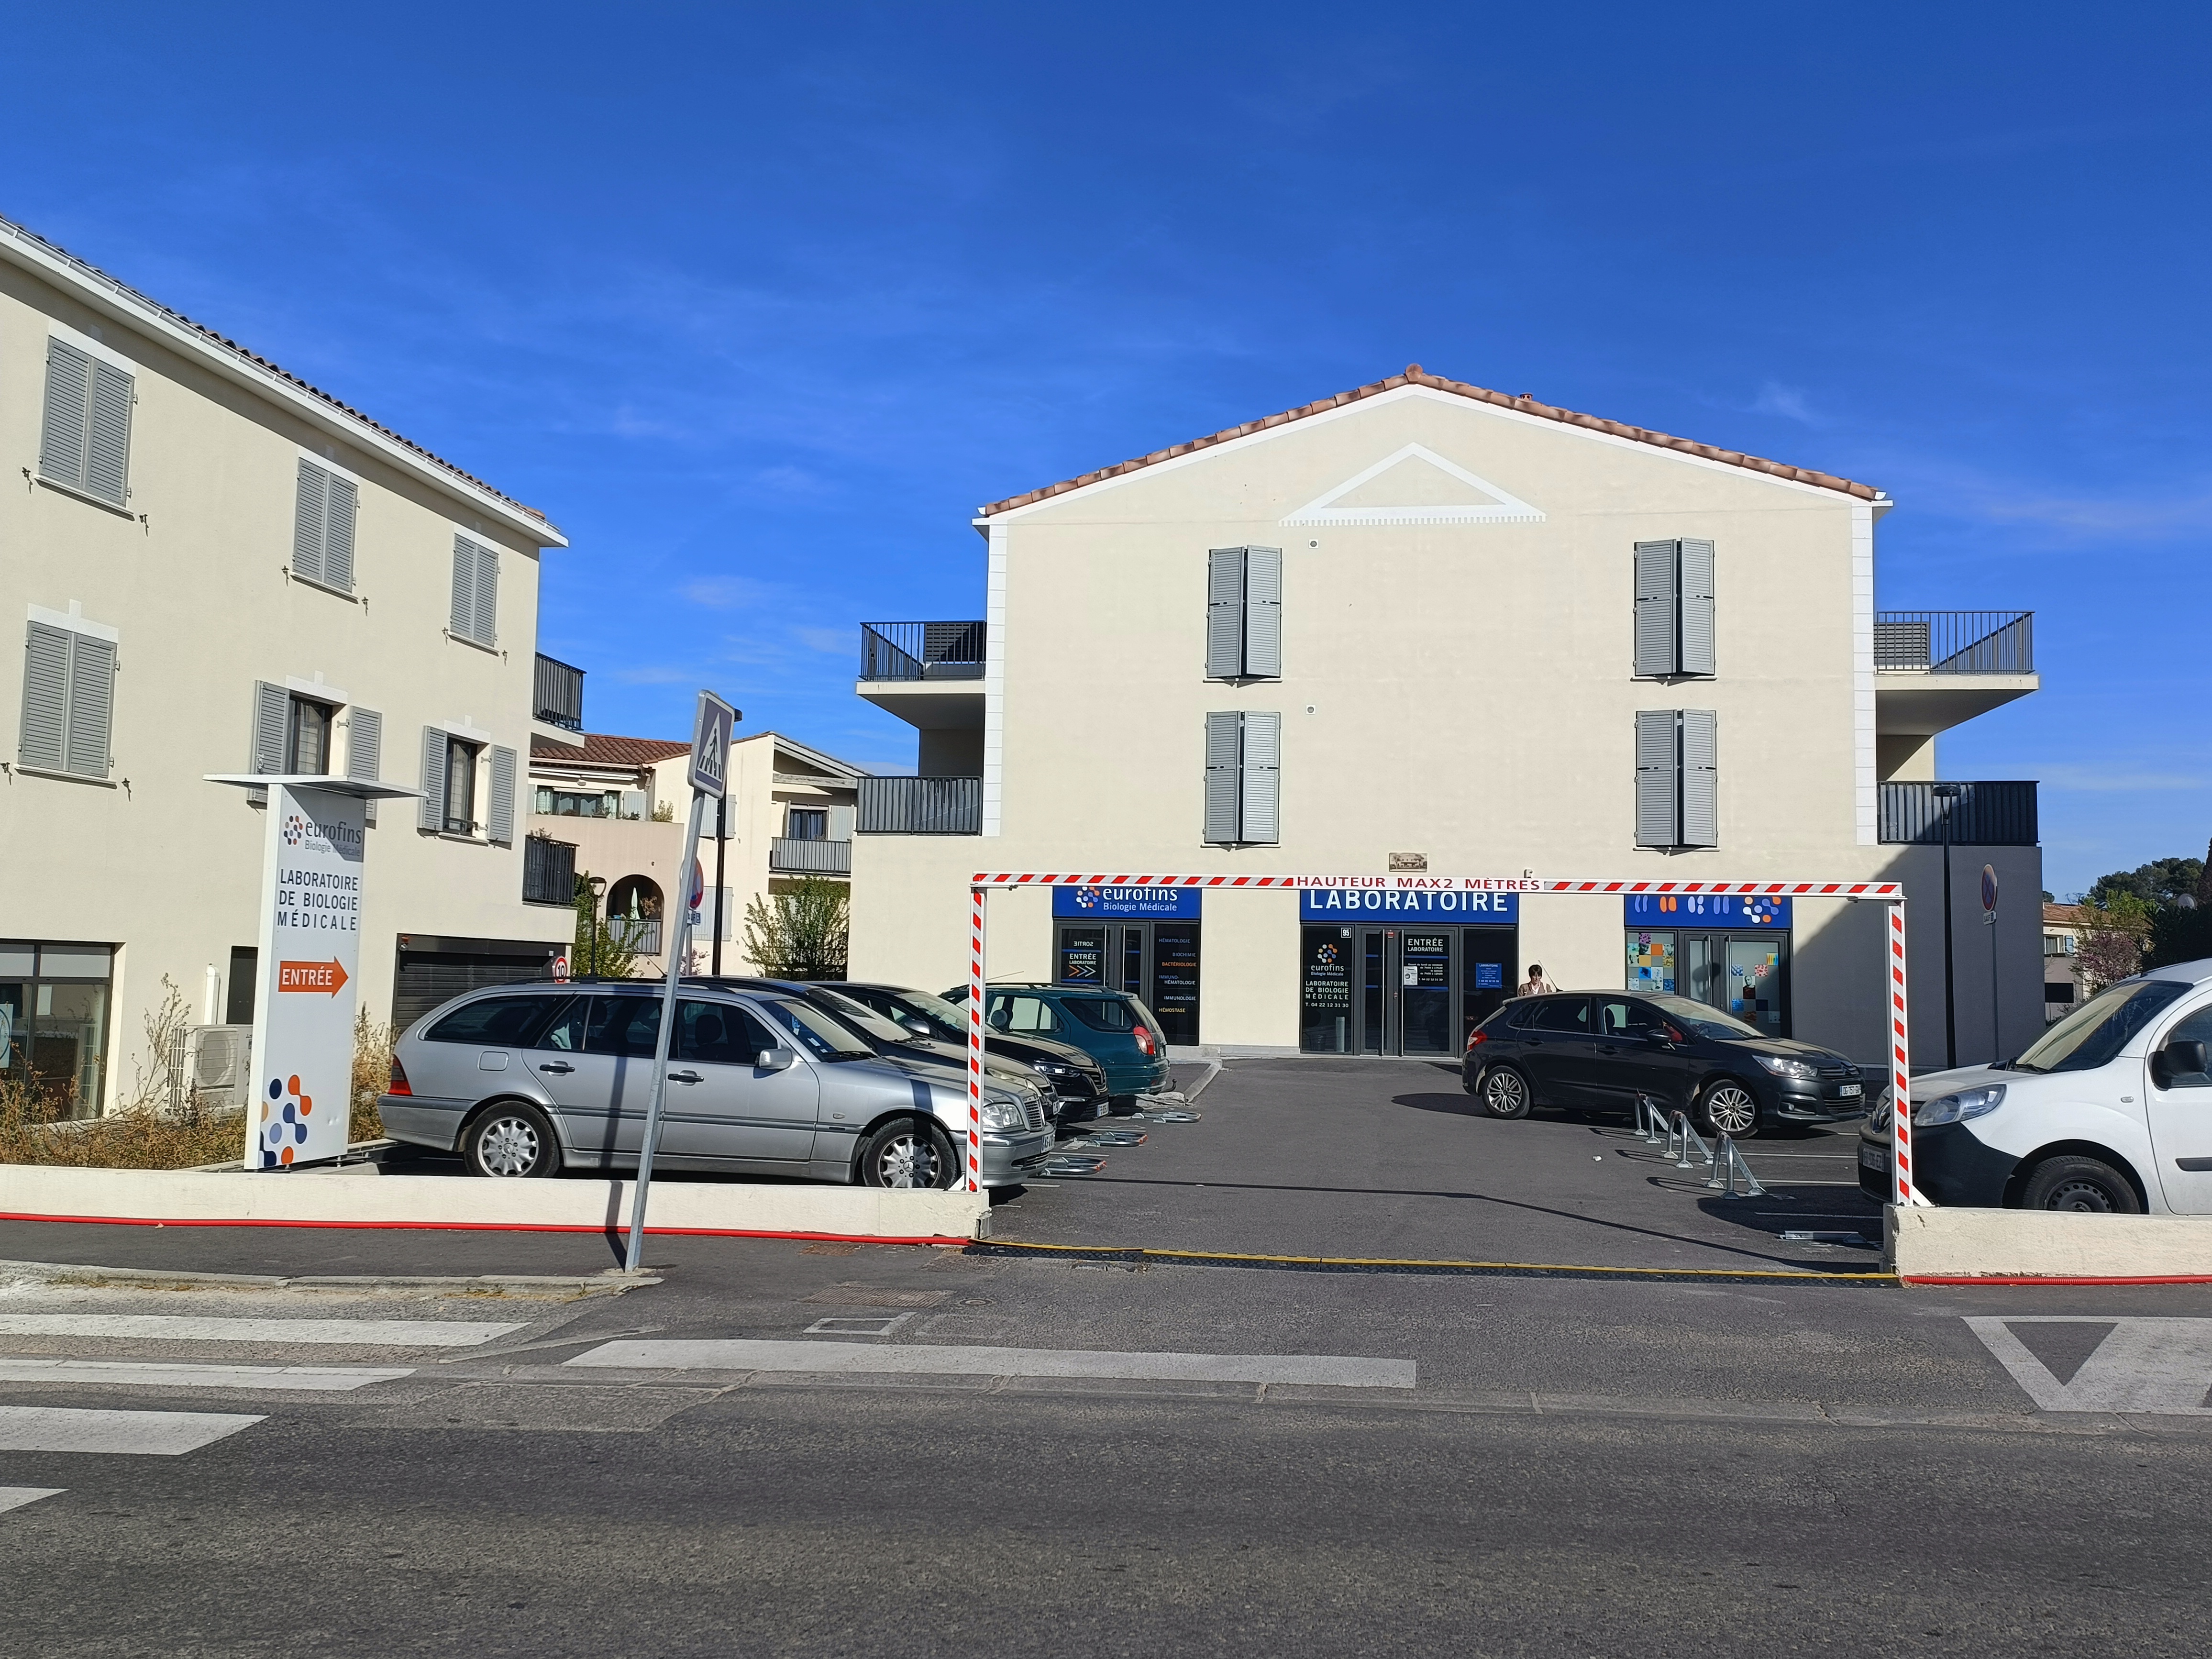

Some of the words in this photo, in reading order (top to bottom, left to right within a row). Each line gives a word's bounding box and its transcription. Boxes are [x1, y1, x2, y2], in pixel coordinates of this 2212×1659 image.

[306, 821, 361, 844] eurofins
[305, 840, 331, 853] Biologie
[332, 844, 360, 856] Médicale
[280, 869, 358, 891] LABORATOIRE
[1297, 877, 1385, 887] HAUTEUR
[279, 890, 295, 906] DE
[303, 892, 358, 911] BIOLOGIE
[1103, 902, 1137, 912] Biologie
[1139, 903, 1177, 911] Médicale
[1310, 890, 1507, 911] LABORATOIRE
[277, 909, 356, 930] MÉDICALE
[1408, 938, 1443, 946] ENTRÉE
[282, 966, 333, 985] ENTRÉE
[558, 965, 564, 976] 10
[1311, 963, 1344, 972] eurofins
